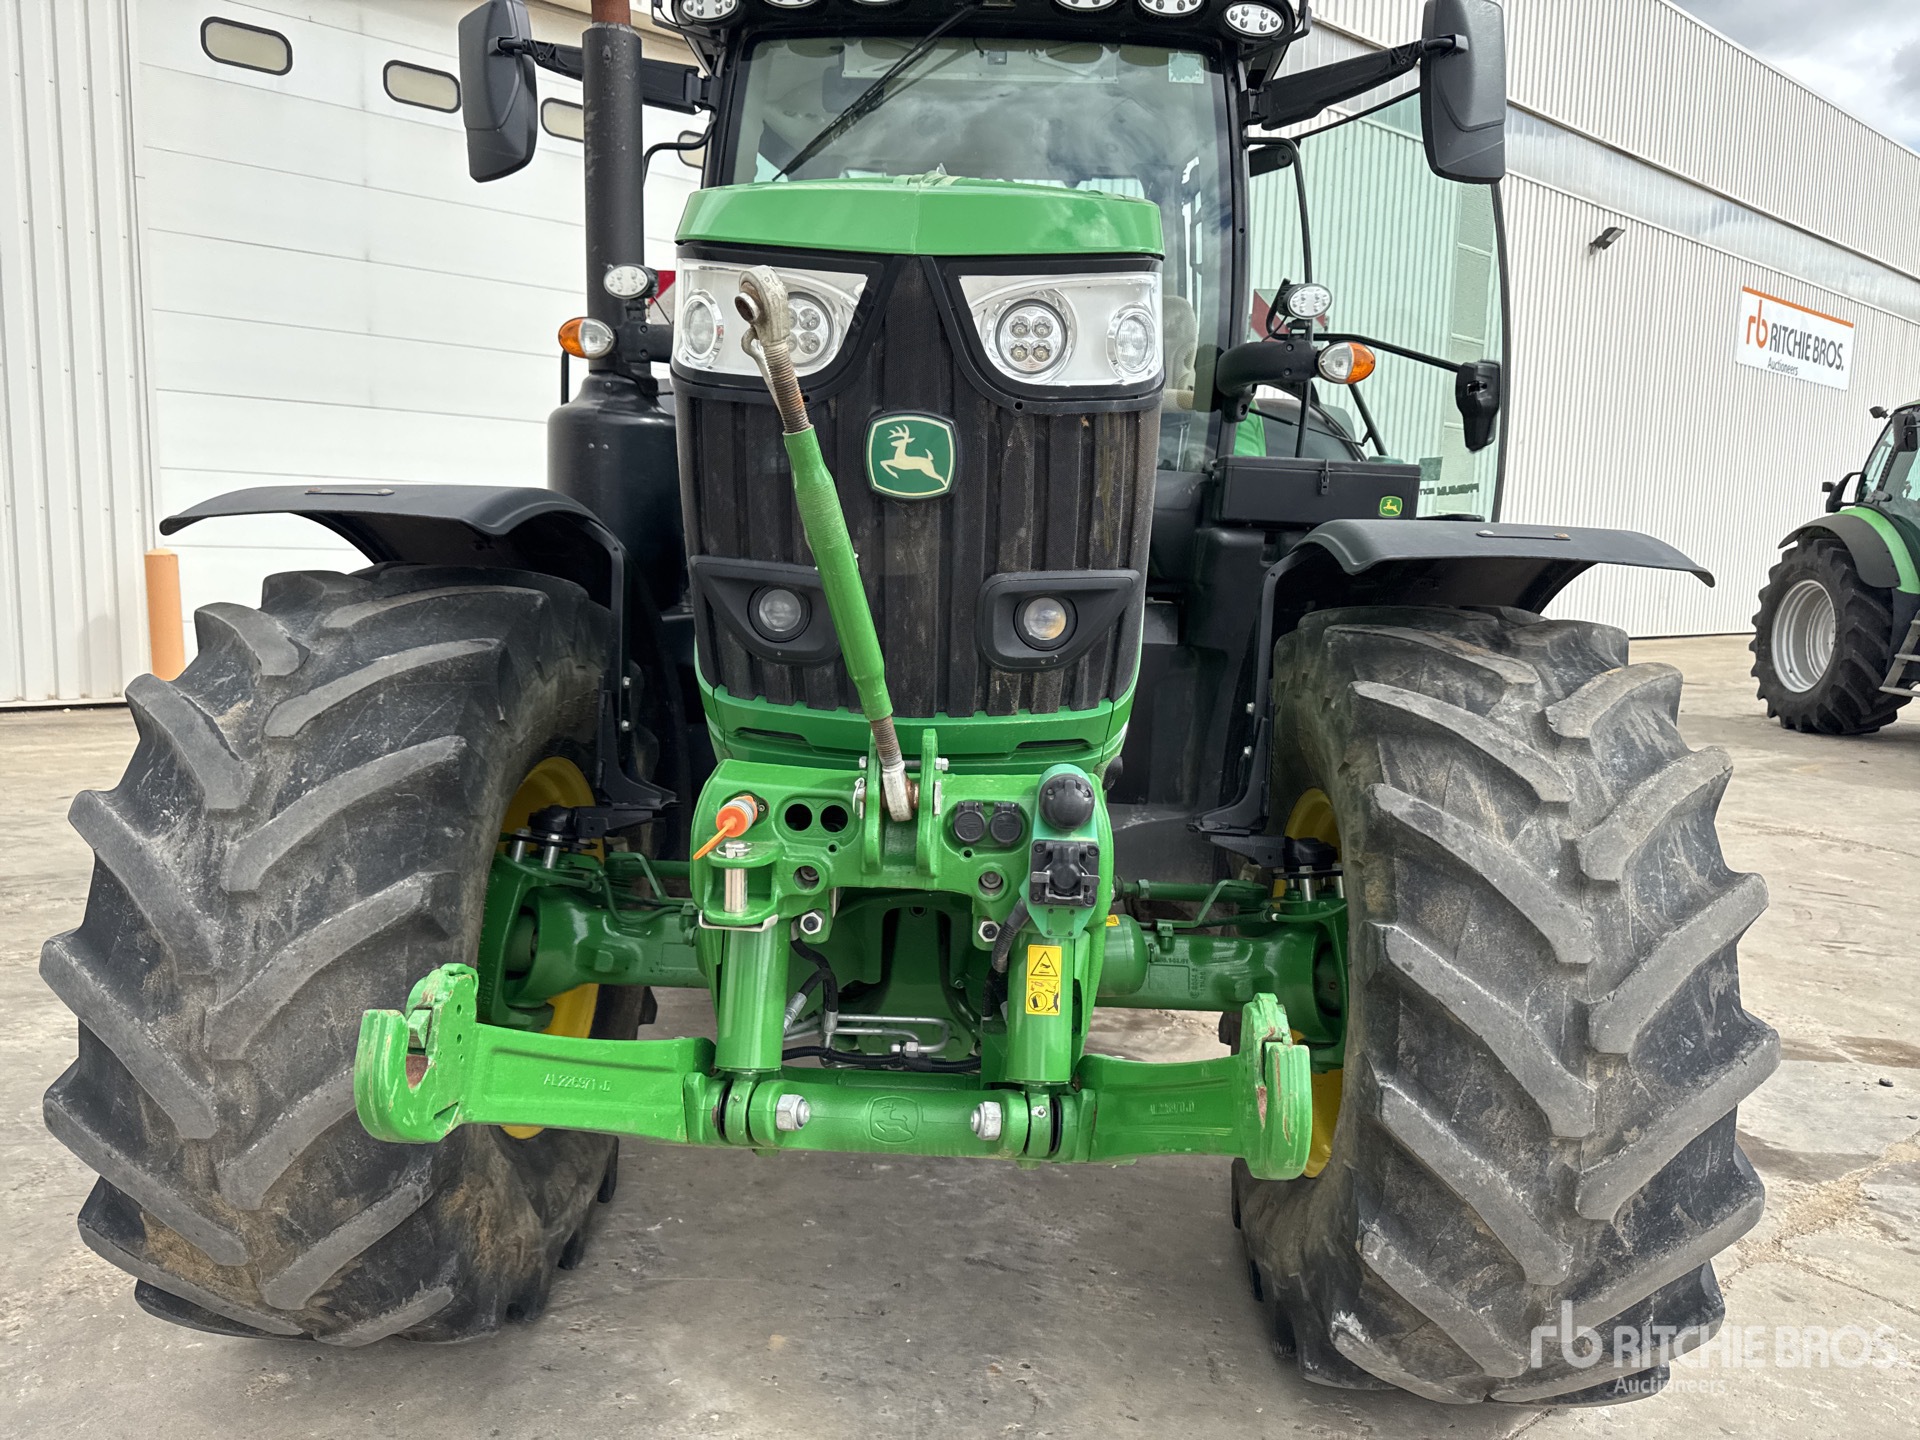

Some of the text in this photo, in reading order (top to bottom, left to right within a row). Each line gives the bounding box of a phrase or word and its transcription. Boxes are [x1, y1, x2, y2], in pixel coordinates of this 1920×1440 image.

[1769, 322, 1844, 371] RITCHIE BROS.
[1767, 356, 1799, 376] Auctioneers
